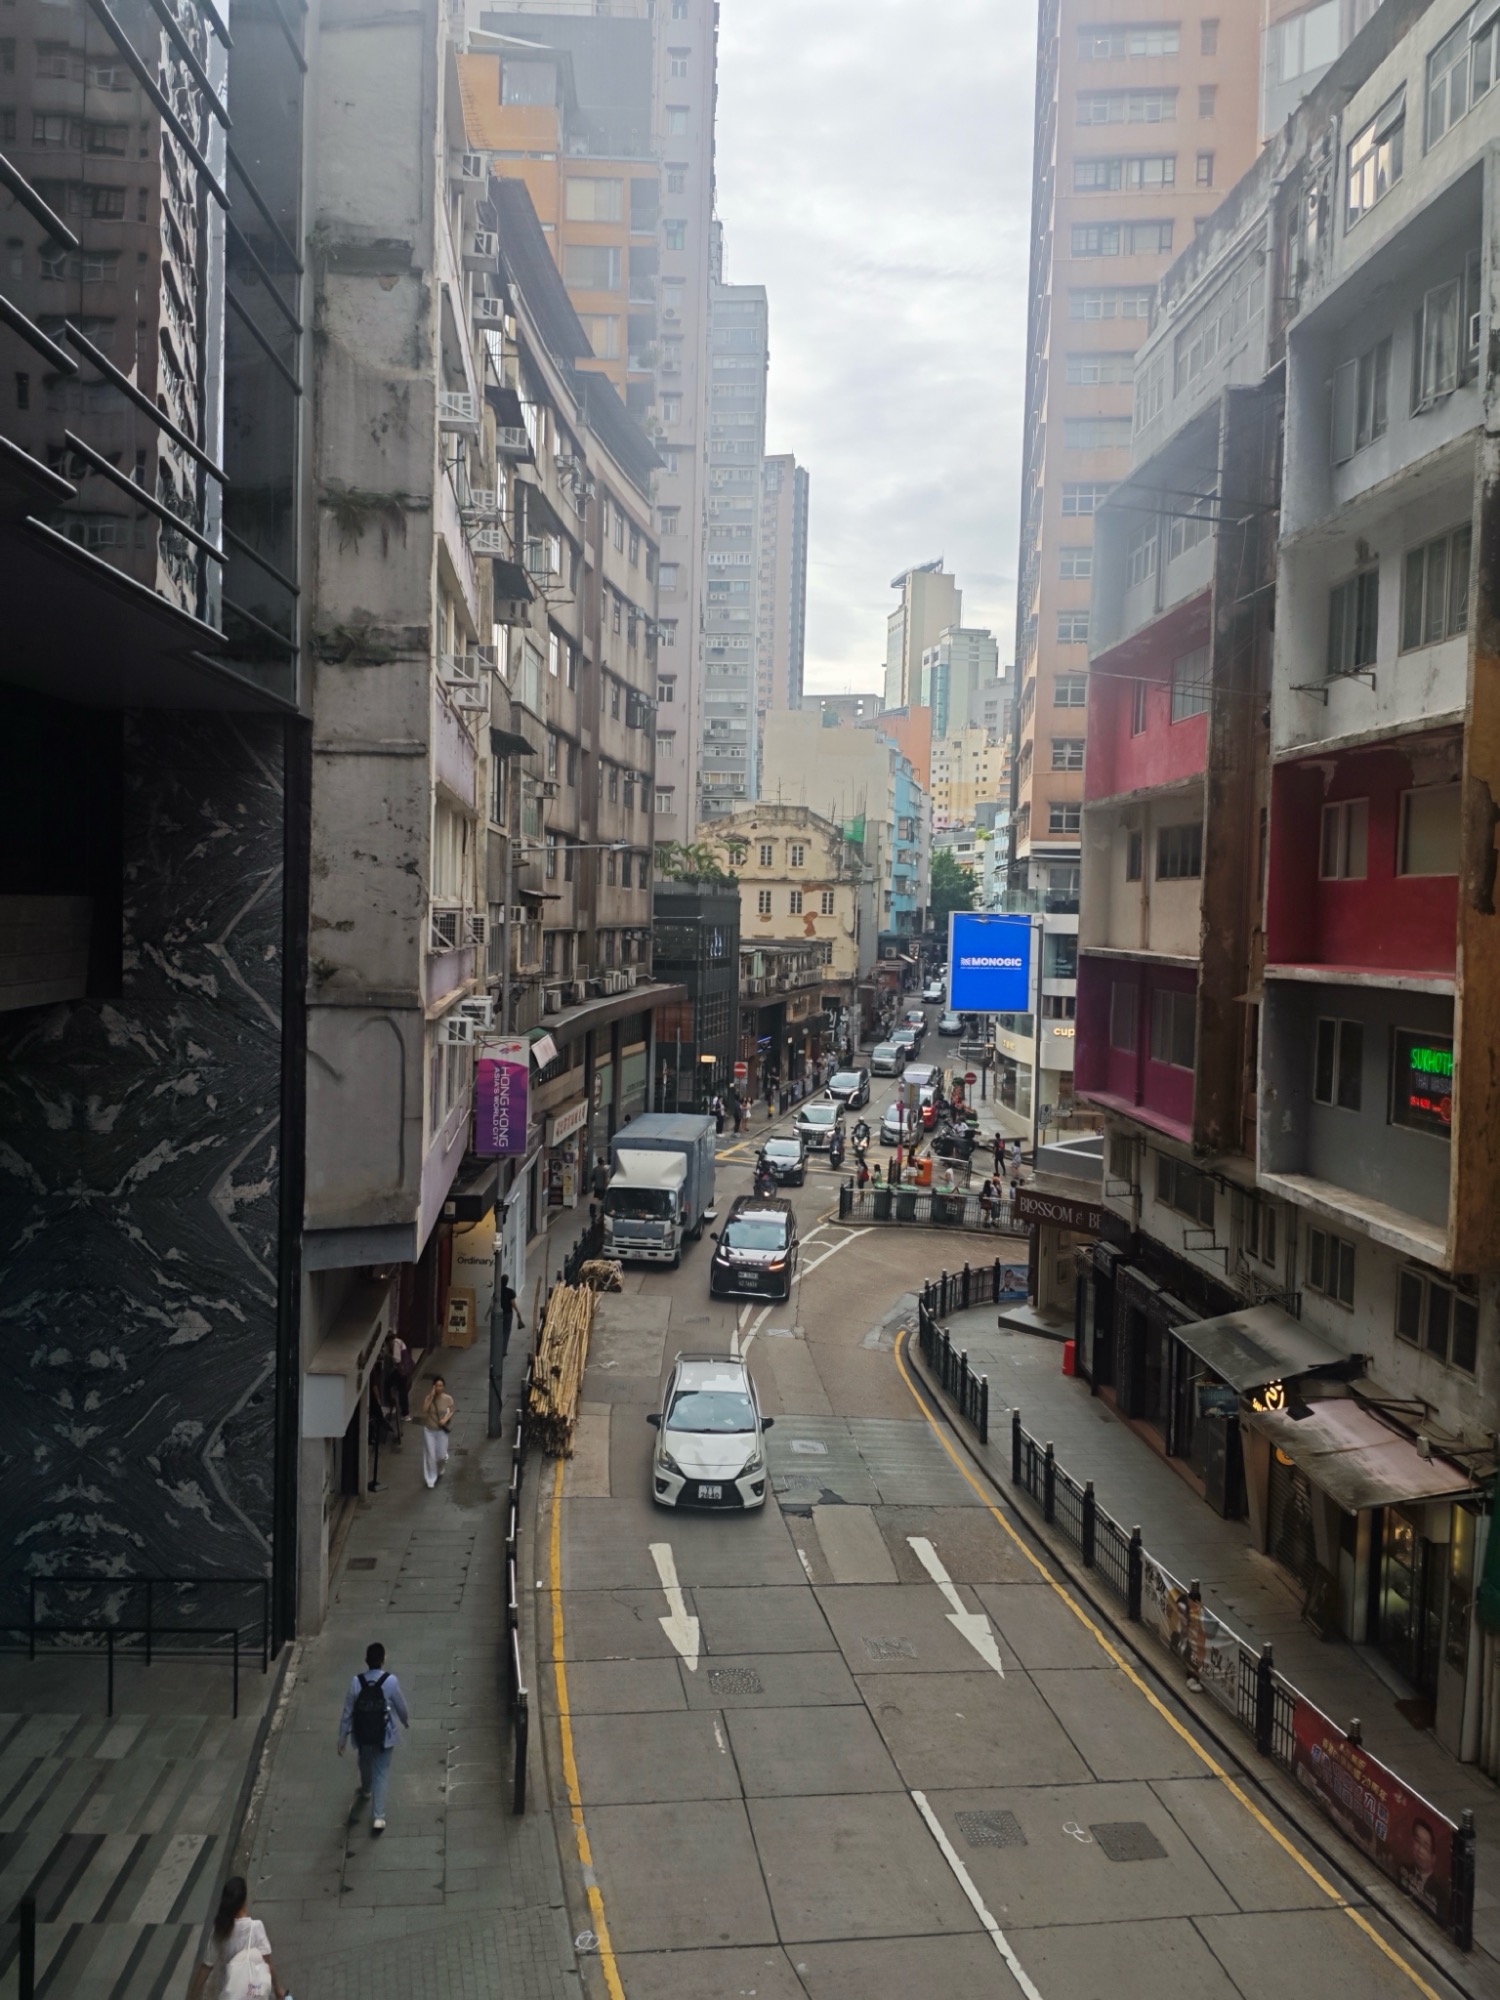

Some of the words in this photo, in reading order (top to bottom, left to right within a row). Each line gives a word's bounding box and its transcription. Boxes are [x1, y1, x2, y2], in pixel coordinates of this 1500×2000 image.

[972, 957, 1022, 967] MONOGIC
[493, 1067, 501, 1095] ASIA'S
[500, 1066, 511, 1106] HONG
[499, 1108, 510, 1147] KONG
[1020, 1197, 1073, 1224] BLOSSOM
[1075, 1210, 1084, 1226] &
